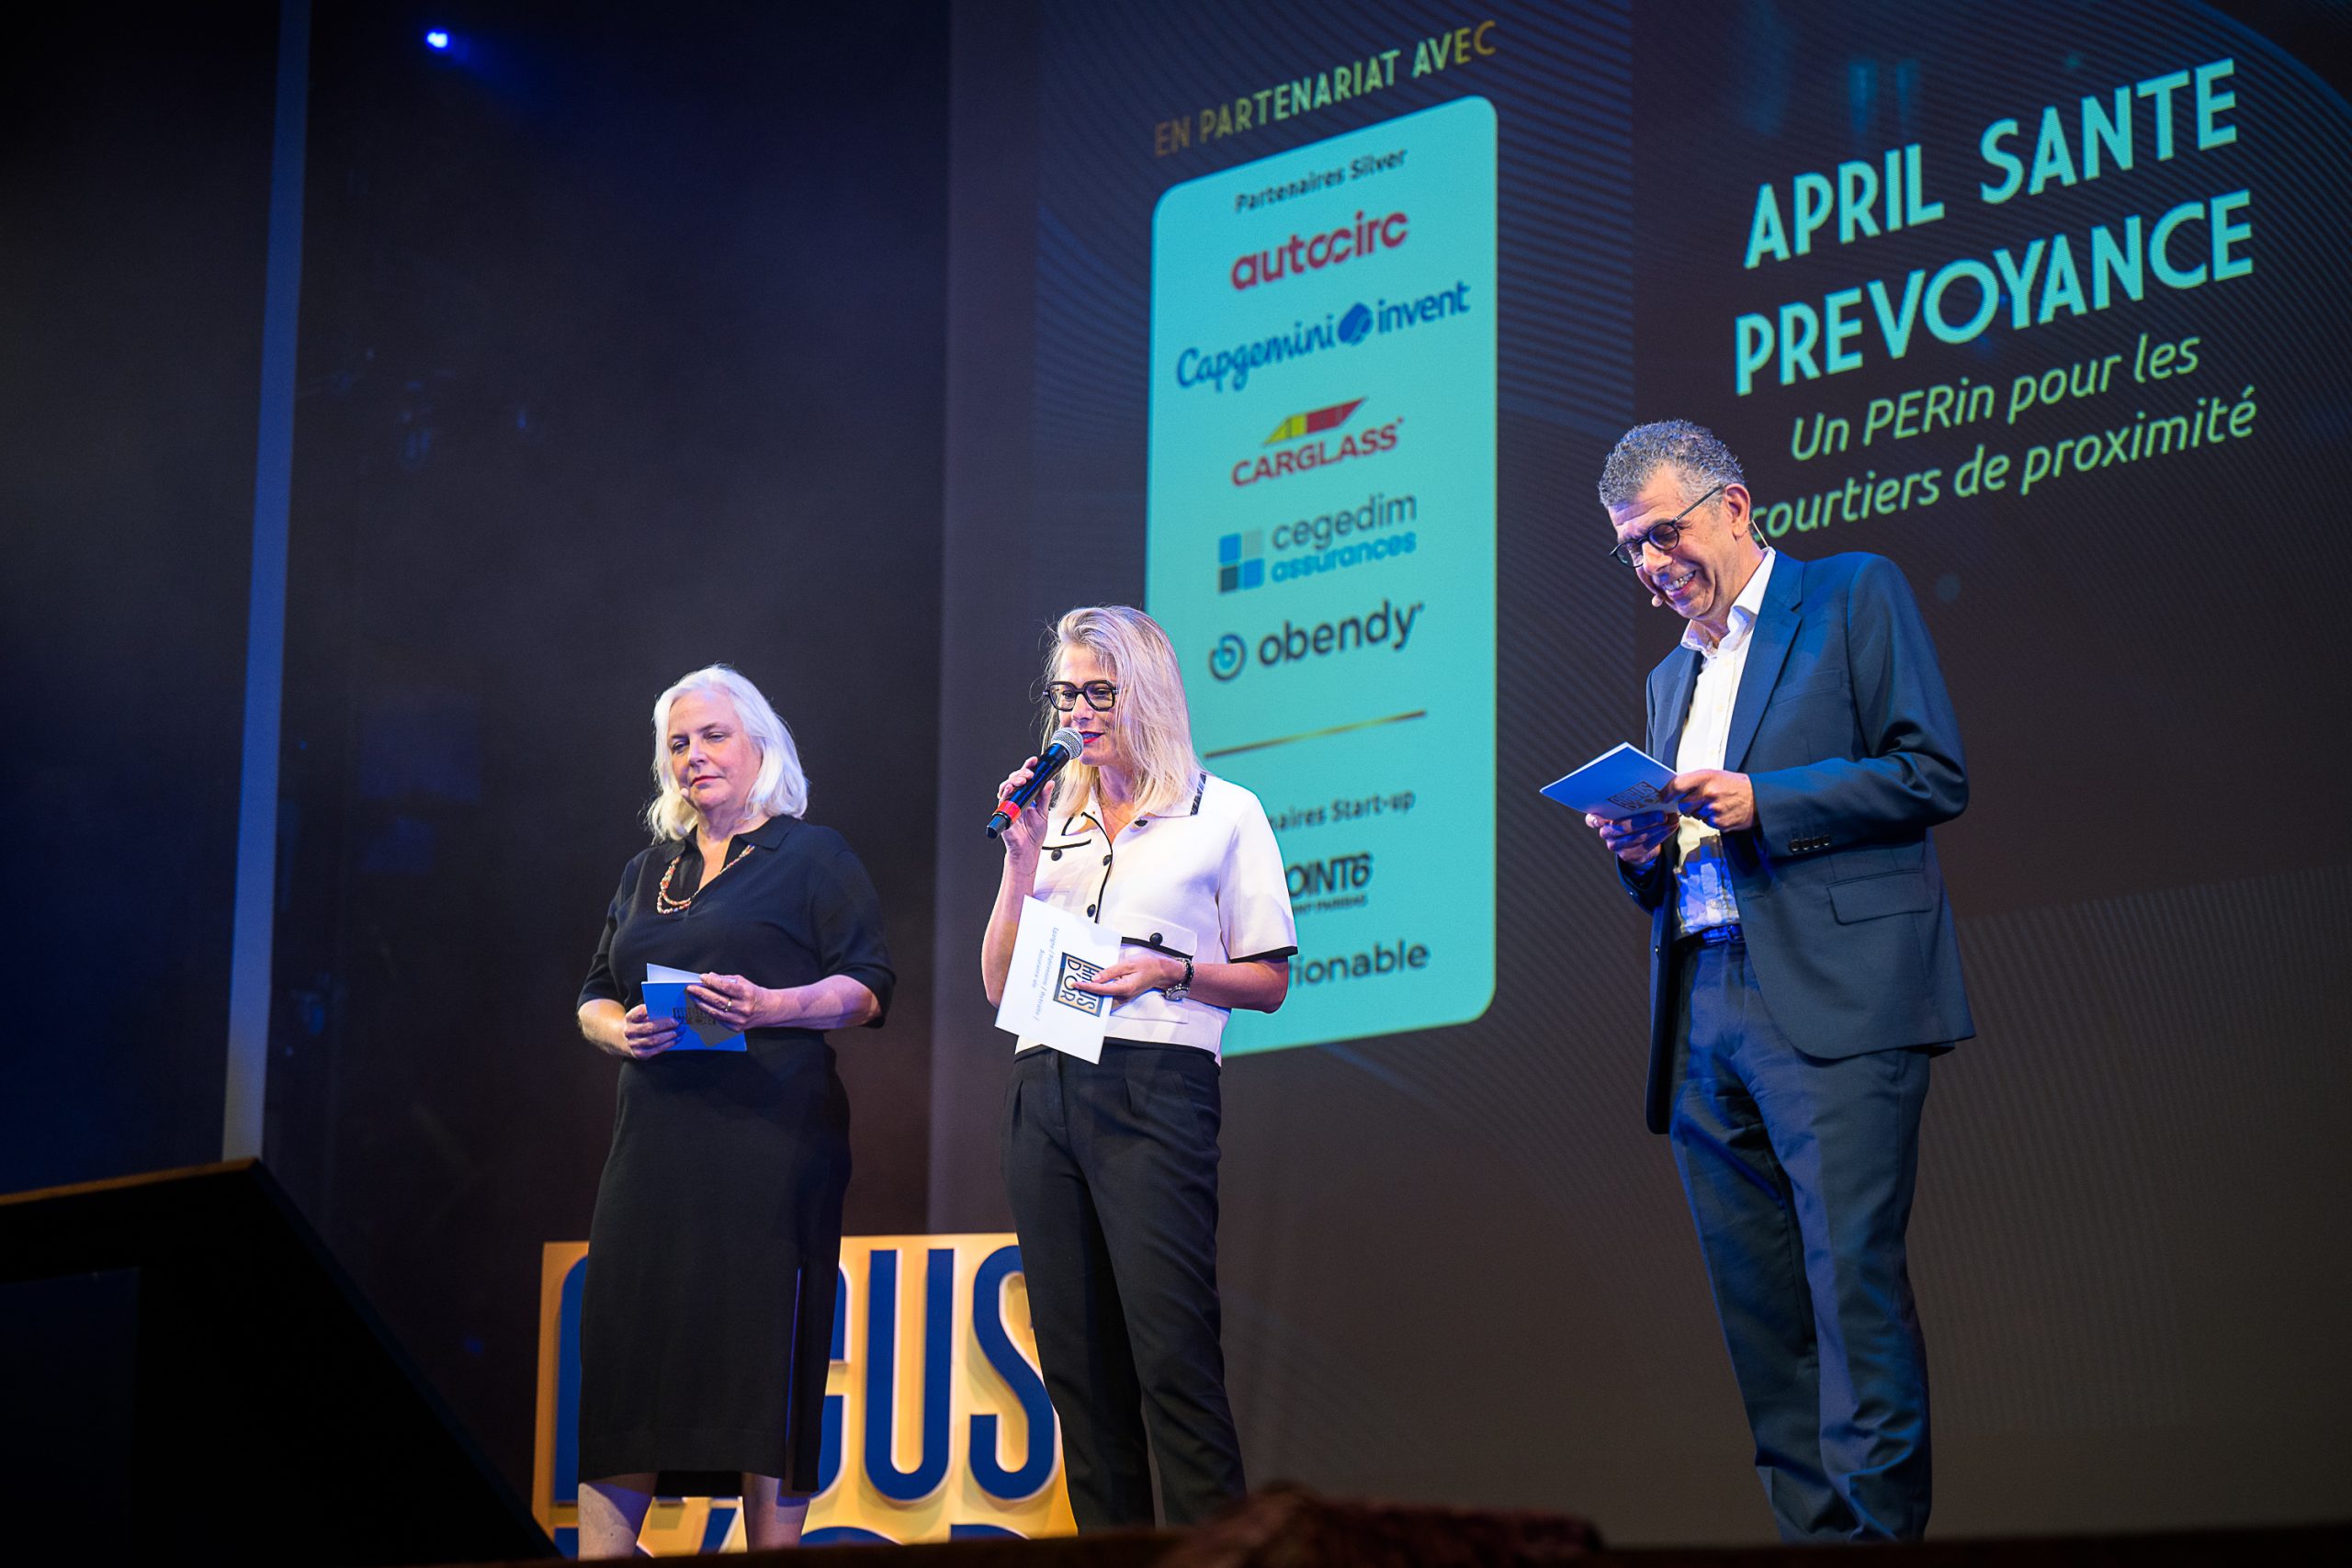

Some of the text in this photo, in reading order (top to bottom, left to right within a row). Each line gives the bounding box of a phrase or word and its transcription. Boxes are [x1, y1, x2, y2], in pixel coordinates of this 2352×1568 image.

[1155, 20, 1496, 157] EN PARTENARIAT AVEC
[1235, 150, 1408, 214] Partenaires Silver
[1745, 58, 2238, 269] APRIL SANTE
[1231, 210, 1408, 291] autocirc
[1736, 190, 2254, 396] PREVOYANCE
[1176, 280, 1471, 393] Capgemini invent
[1792, 334, 2200, 460] Un PERin pour les
[1232, 423, 1399, 487] CARGLASS
[1954, 444, 2009, 498] de
[2021, 386, 2257, 495] proximité
[1272, 493, 1417, 550] cegedim
[1271, 531, 1417, 583] assurances
[1258, 598, 1418, 667] obendy
[1331, 791, 1416, 822] Start-up
[1285, 852, 1372, 897] OINT6
[1289, 939, 1430, 987] ionable
